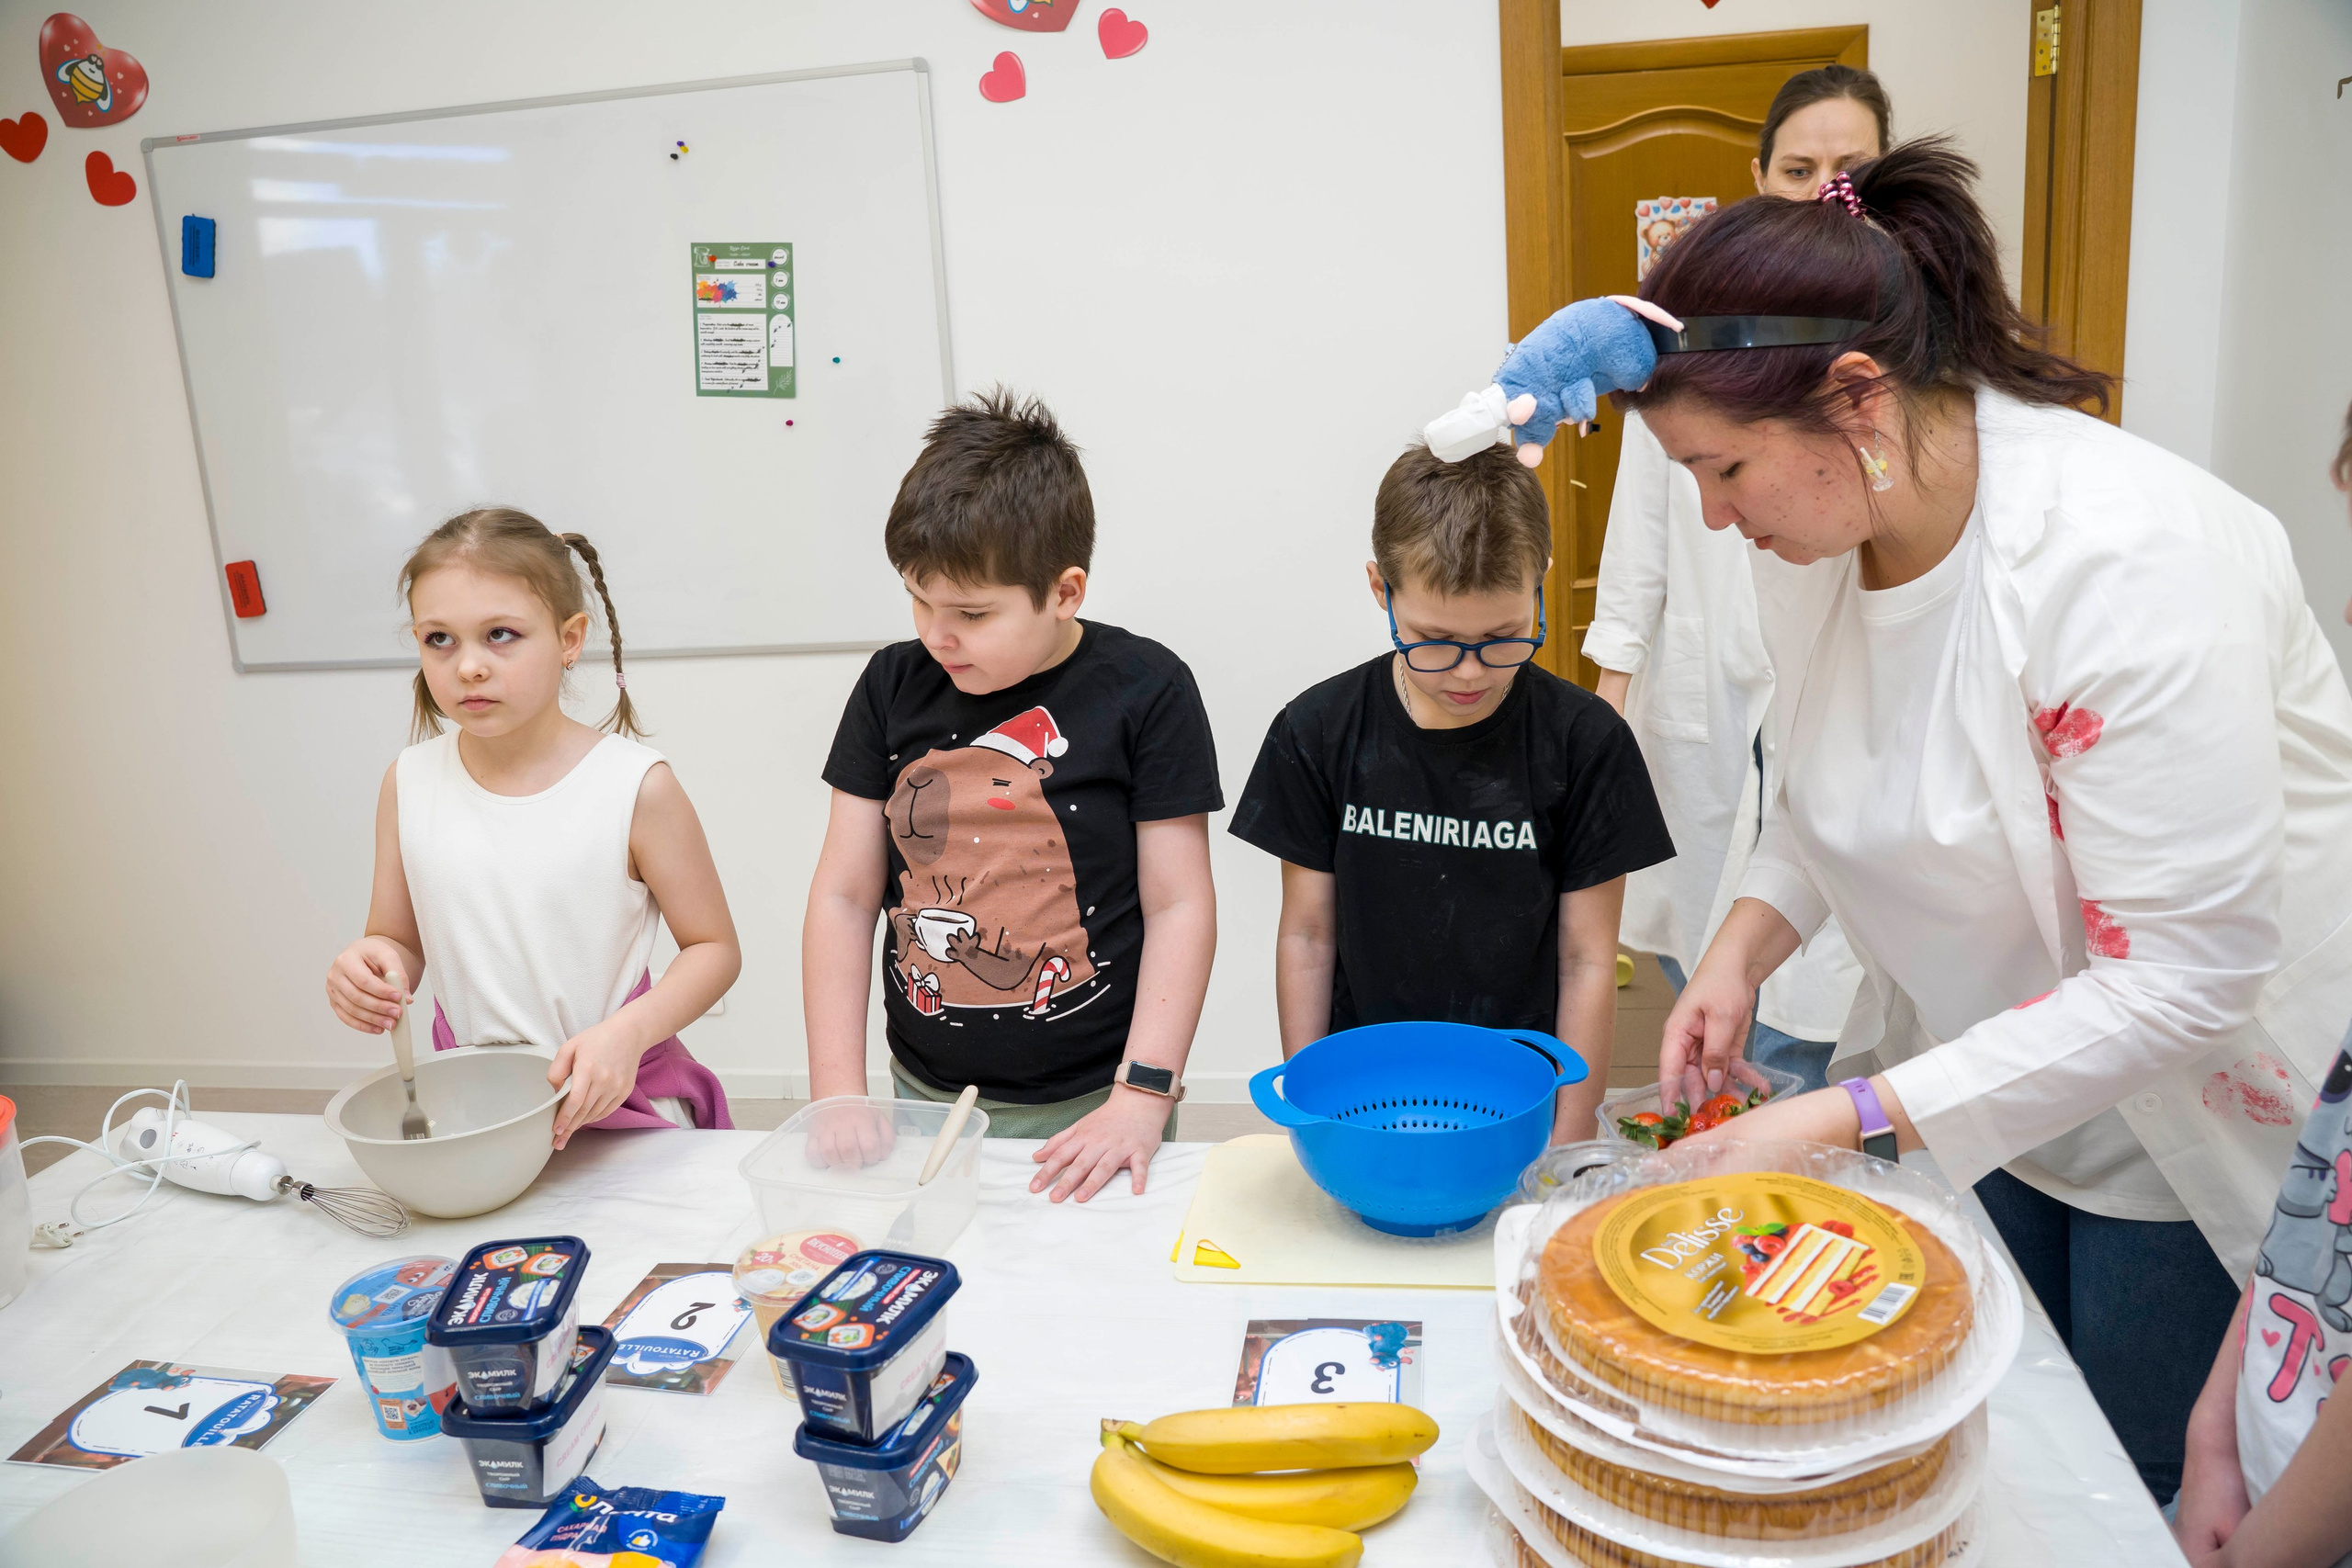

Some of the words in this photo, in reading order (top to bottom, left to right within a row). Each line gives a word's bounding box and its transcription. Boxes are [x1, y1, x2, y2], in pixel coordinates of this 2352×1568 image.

[1342, 803, 1538, 850] BALENIRIAGA
[479, 1276, 512, 1323] СЛИВОЧНЫЙ
[859, 1266, 911, 1312] СЛИВОЧНЫЙ
[670, 1302, 716, 1330] 2
[617, 1343, 701, 1357] RATATOUILLE
[1310, 1361, 1346, 1394] 3
[475, 1392, 521, 1401] СЛИВОЧНЫЙ
[556, 1434, 579, 1467] CREAM
